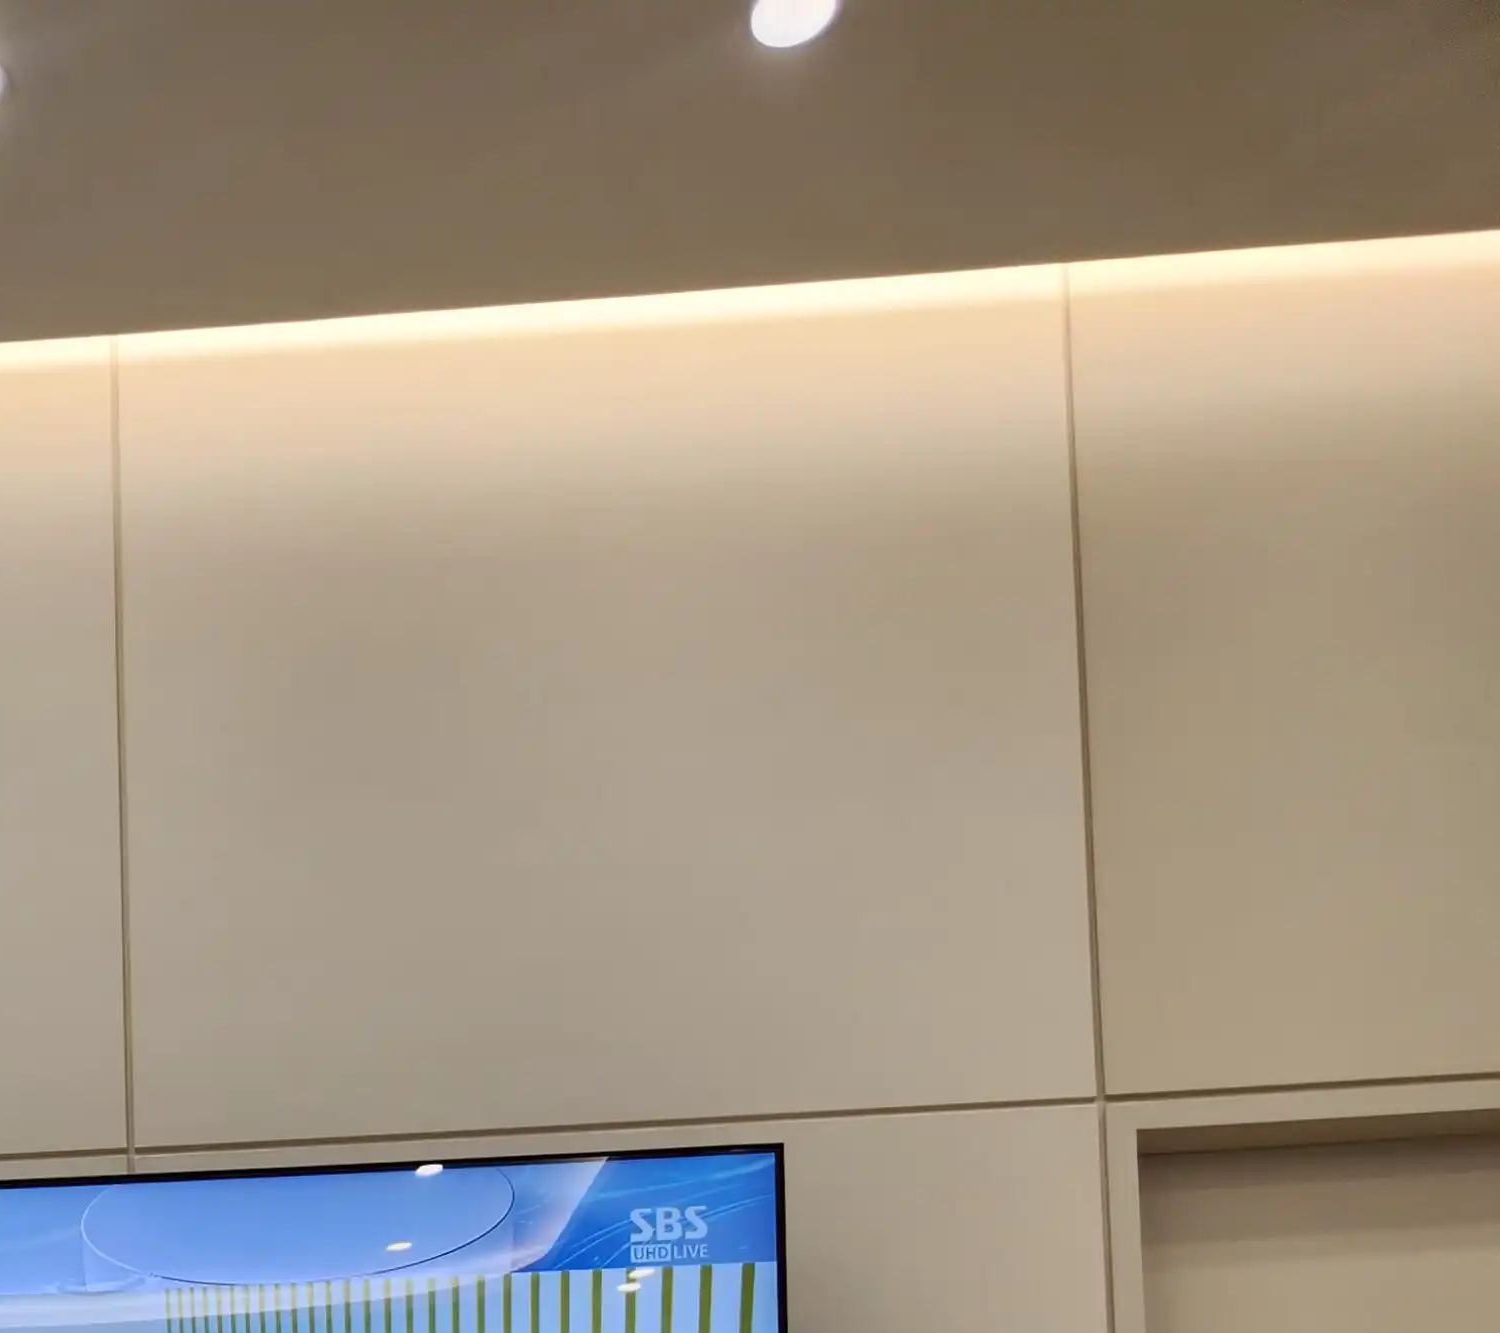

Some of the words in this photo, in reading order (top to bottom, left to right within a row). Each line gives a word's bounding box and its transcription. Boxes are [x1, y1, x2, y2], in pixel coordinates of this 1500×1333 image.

[630, 1205, 708, 1242] SBS
[632, 1245, 670, 1261] UHD
[674, 1244, 709, 1259] LIVE
